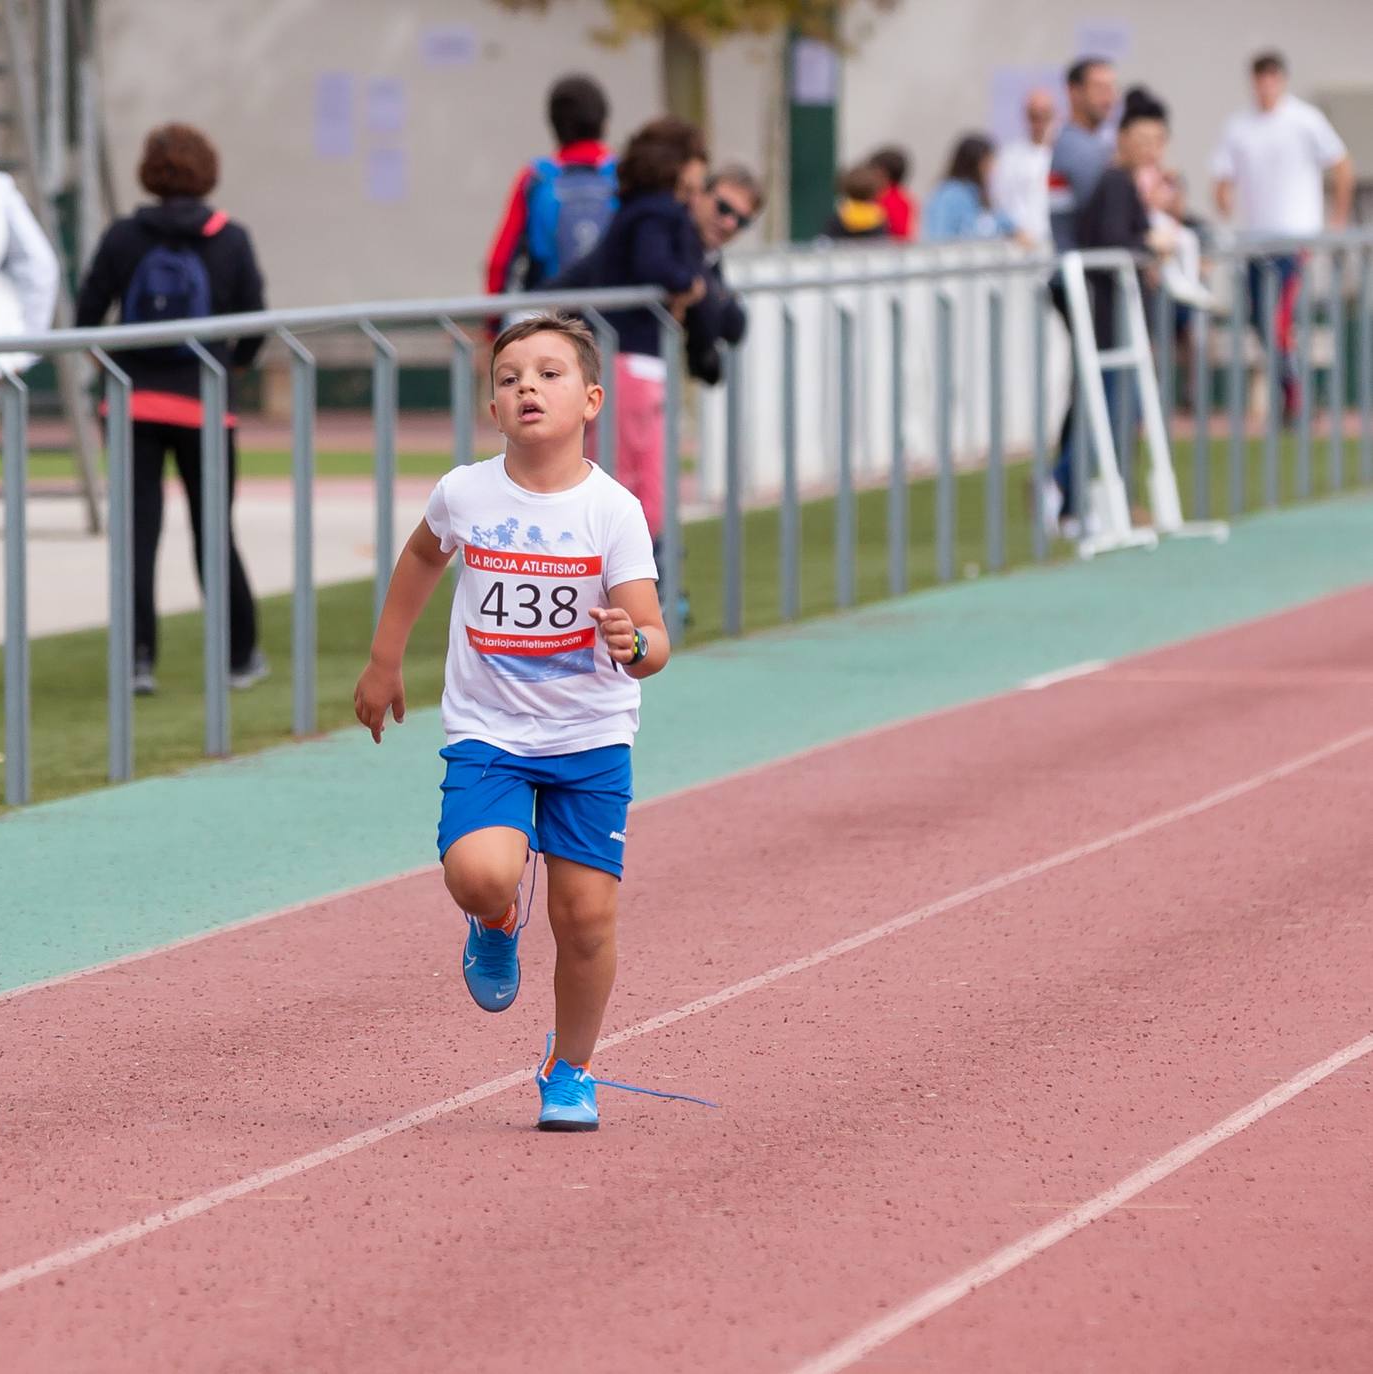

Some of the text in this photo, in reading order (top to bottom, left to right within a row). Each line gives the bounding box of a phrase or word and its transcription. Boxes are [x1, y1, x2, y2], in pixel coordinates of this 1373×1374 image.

[470, 553, 587, 575] LA RIOJA ATLETISMO
[480, 581, 578, 629] 438
